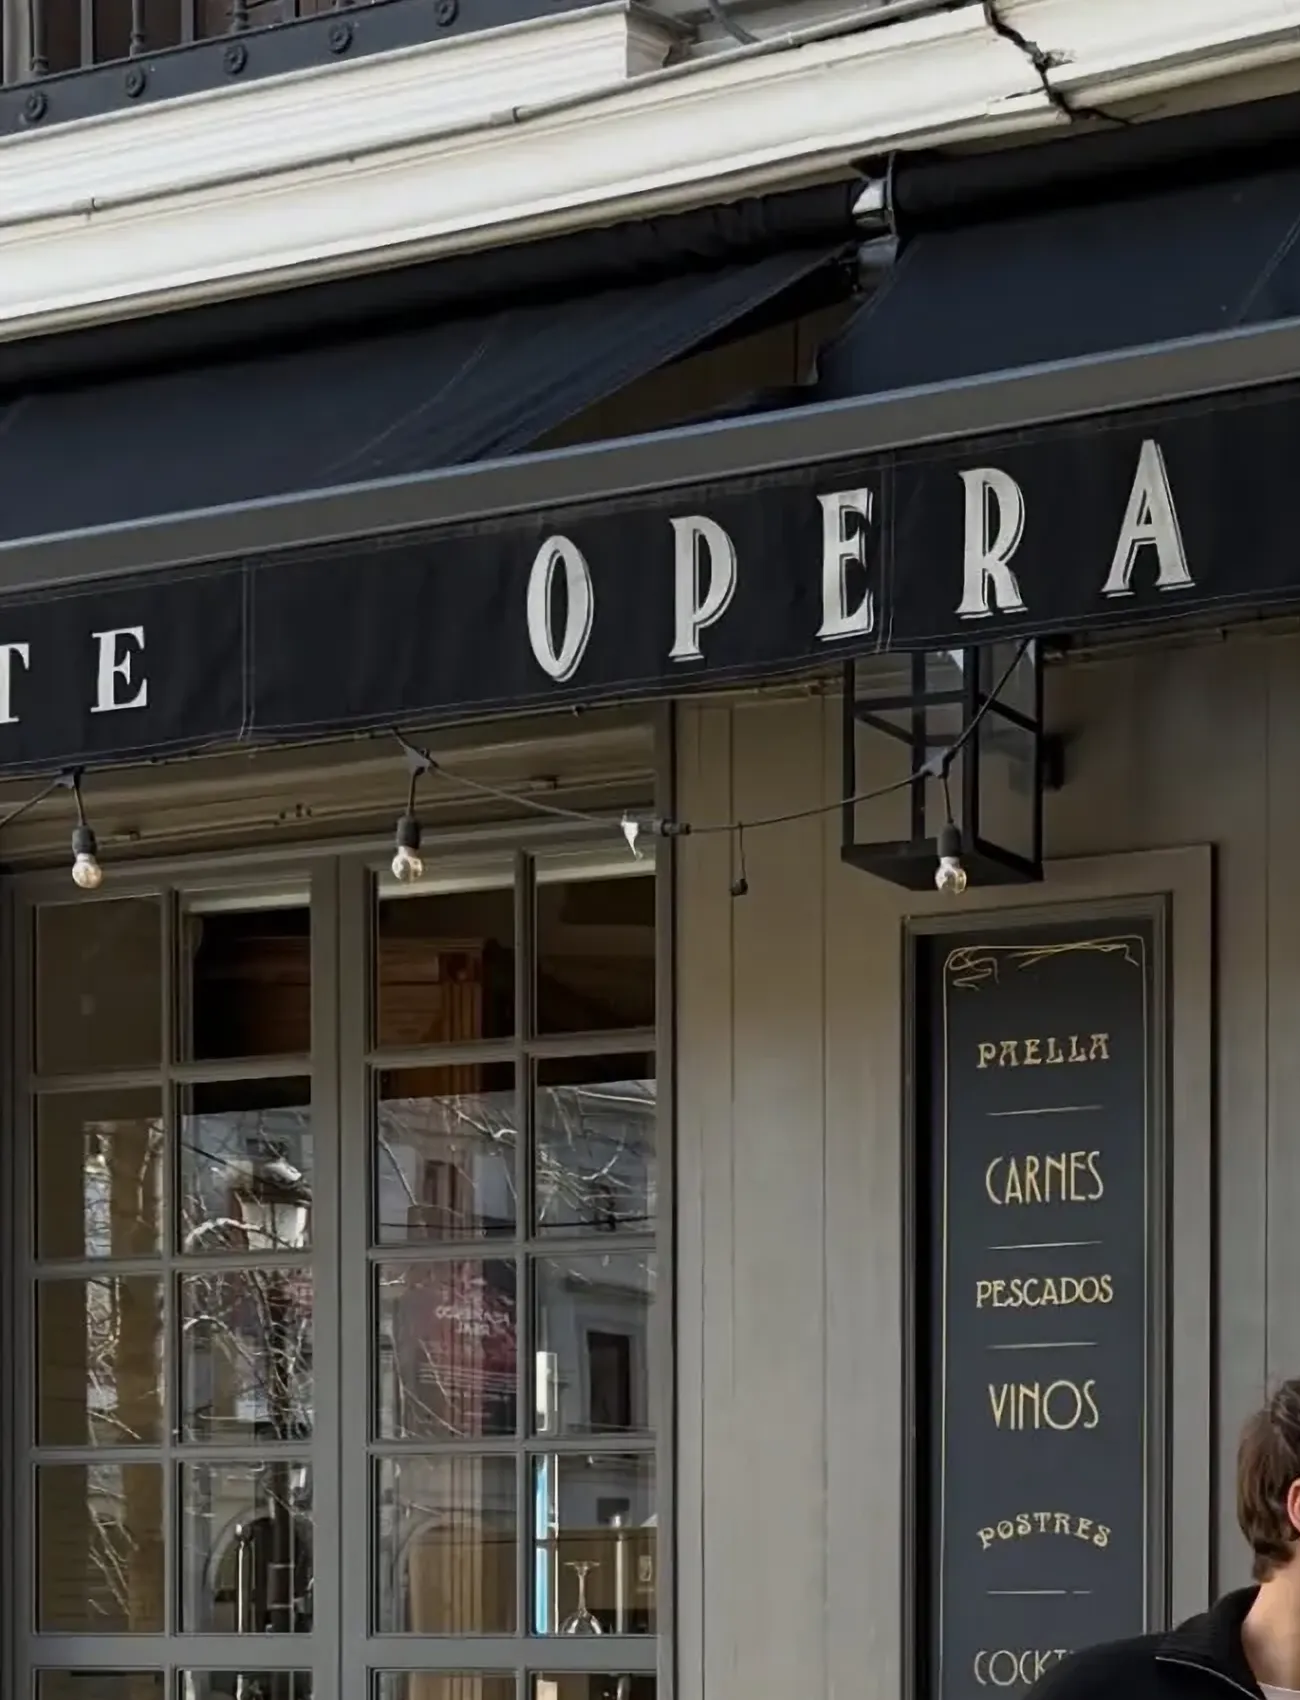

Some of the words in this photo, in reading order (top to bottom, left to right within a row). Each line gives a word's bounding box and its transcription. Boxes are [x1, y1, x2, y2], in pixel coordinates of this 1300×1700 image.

[527, 439, 1196, 682] OPERA
[976, 1032, 1110, 1069] PAELLA
[985, 1150, 1104, 1204] CARNES
[976, 1274, 1114, 1308] PESCADOS
[988, 1379, 1099, 1430] VINOS
[976, 1511, 1112, 1550] POSTRES
